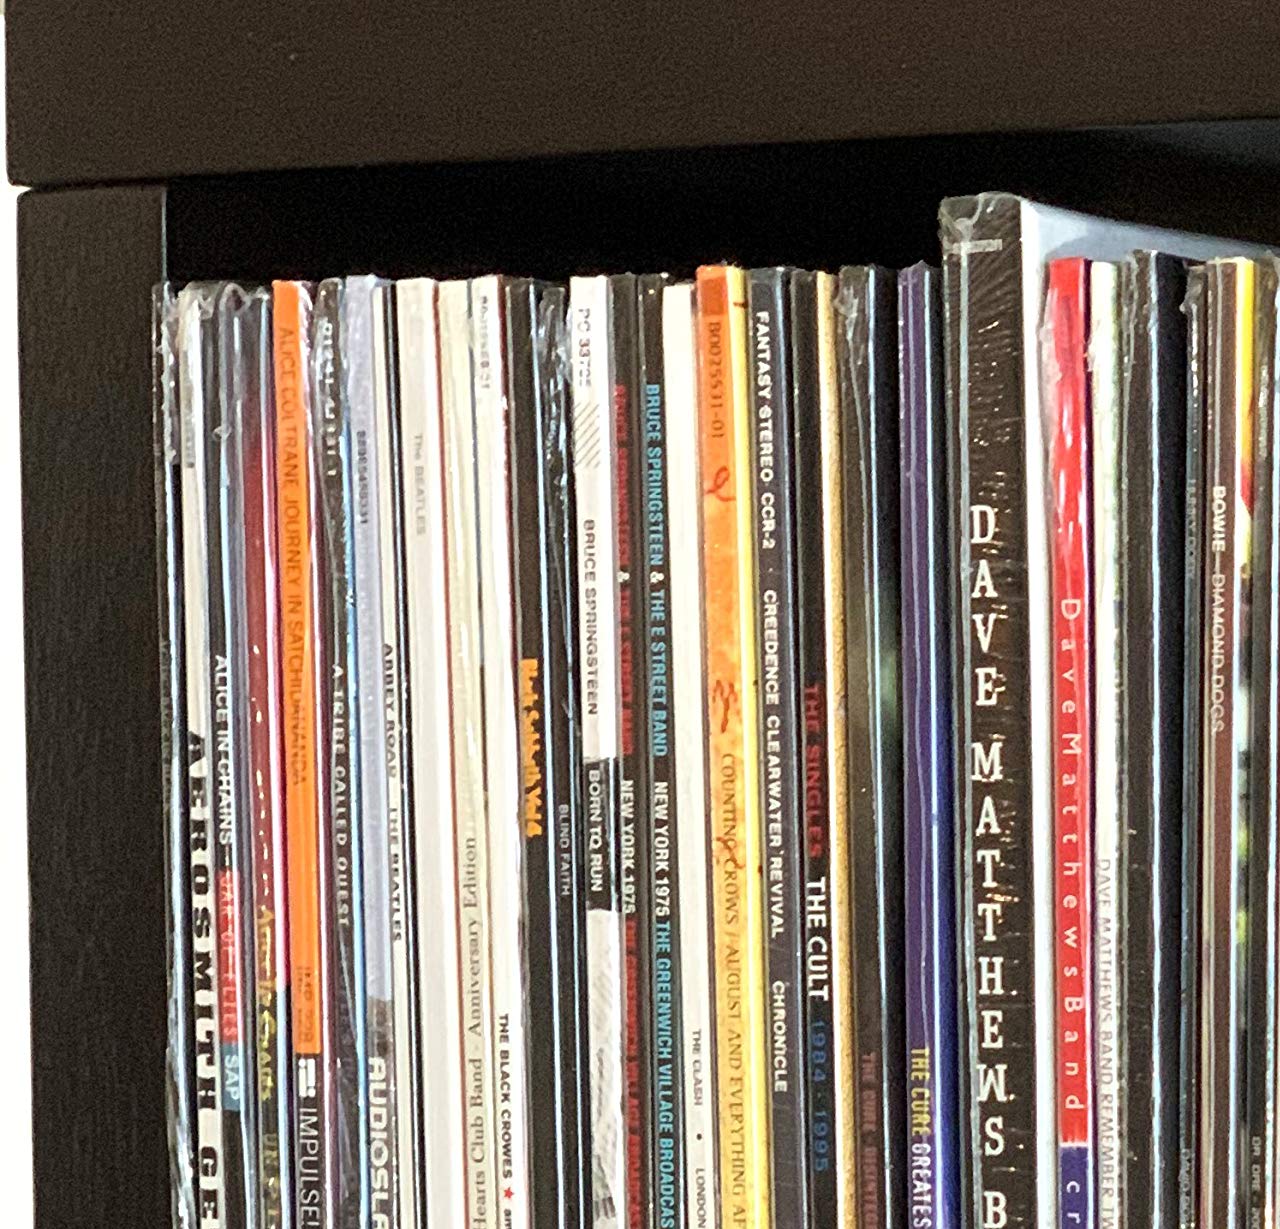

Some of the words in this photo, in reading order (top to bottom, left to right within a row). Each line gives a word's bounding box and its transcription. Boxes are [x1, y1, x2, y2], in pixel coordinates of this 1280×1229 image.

[756, 311, 771, 398] FANTASY
[645, 385, 661, 440] BRUCE
[759, 405, 774, 482] STEREO
[415, 466, 426, 535] BEATLES
[647, 447, 662, 565] SPRINGSTEEN
[761, 492, 775, 549] CCR-2
[583, 520, 597, 582] BRUCE
[650, 571, 664, 583] &
[651, 590, 665, 620] THE
[652, 627, 666, 637] E
[971, 505, 1000, 706] DAVE
[382, 644, 396, 710] ABBEY
[584, 589, 599, 715] SPRINGSTEEN
[652, 642, 667, 704] STREET
[763, 590, 779, 705] CREEDENCE
[653, 710, 668, 756] BAND
[804, 685, 819, 731] THE
[386, 719, 398, 779] ROAD
[588, 771, 601, 820] BORN
[654, 782, 668, 821] NEW
[719, 753, 737, 850] COUNTING
[766, 715, 782, 847] CLEARWATER
[806, 744, 821, 857] SINGLES
[389, 807, 400, 846] THE
[558, 805, 570, 848] BLIND
[589, 826, 602, 849] TO
[655, 826, 669, 873] YORK
[390, 853, 402, 941] BEATLES
[560, 853, 571, 895] FAITH
[590, 855, 603, 891] RUN
[656, 878, 670, 916] 1975
[723, 858, 739, 924] CROWS
[769, 856, 785, 938] REVIVAL
[806, 877, 826, 930] THE
[1098, 860, 1111, 908] DAVE
[189, 731, 217, 1110] AEROSMITH
[656, 922, 670, 951] THE
[971, 743, 1008, 1155] MATTHEWS
[726, 946, 743, 1019] AUGUST
[807, 937, 828, 1001] CULT
[1099, 917, 1112, 1023] MATTHEWS
[498, 1014, 509, 1044] THE
[657, 957, 673, 1058] GREENWICH
[772, 981, 787, 1092] CHRONICLE
[691, 1030, 702, 1056] THE
[728, 1030, 743, 1069] AND
[811, 1020, 826, 1082] 1984
[911, 1047, 930, 1080] THE
[1100, 1031, 1113, 1086] BAND
[500, 1050, 511, 1103] BLACK
[659, 1066, 674, 1133] VILLAGE
[692, 1060, 703, 1105] CLASH
[729, 1077, 746, 1196] EVERYTHING
[813, 1110, 828, 1172] 1995
[911, 1088, 931, 1136] CURE
[300, 1108, 319, 1226] IMPULSE!
[501, 1110, 513, 1179] CROWES
[1100, 1094, 1115, 1198] REMEMBER
[695, 1168, 707, 1226] LONDON
